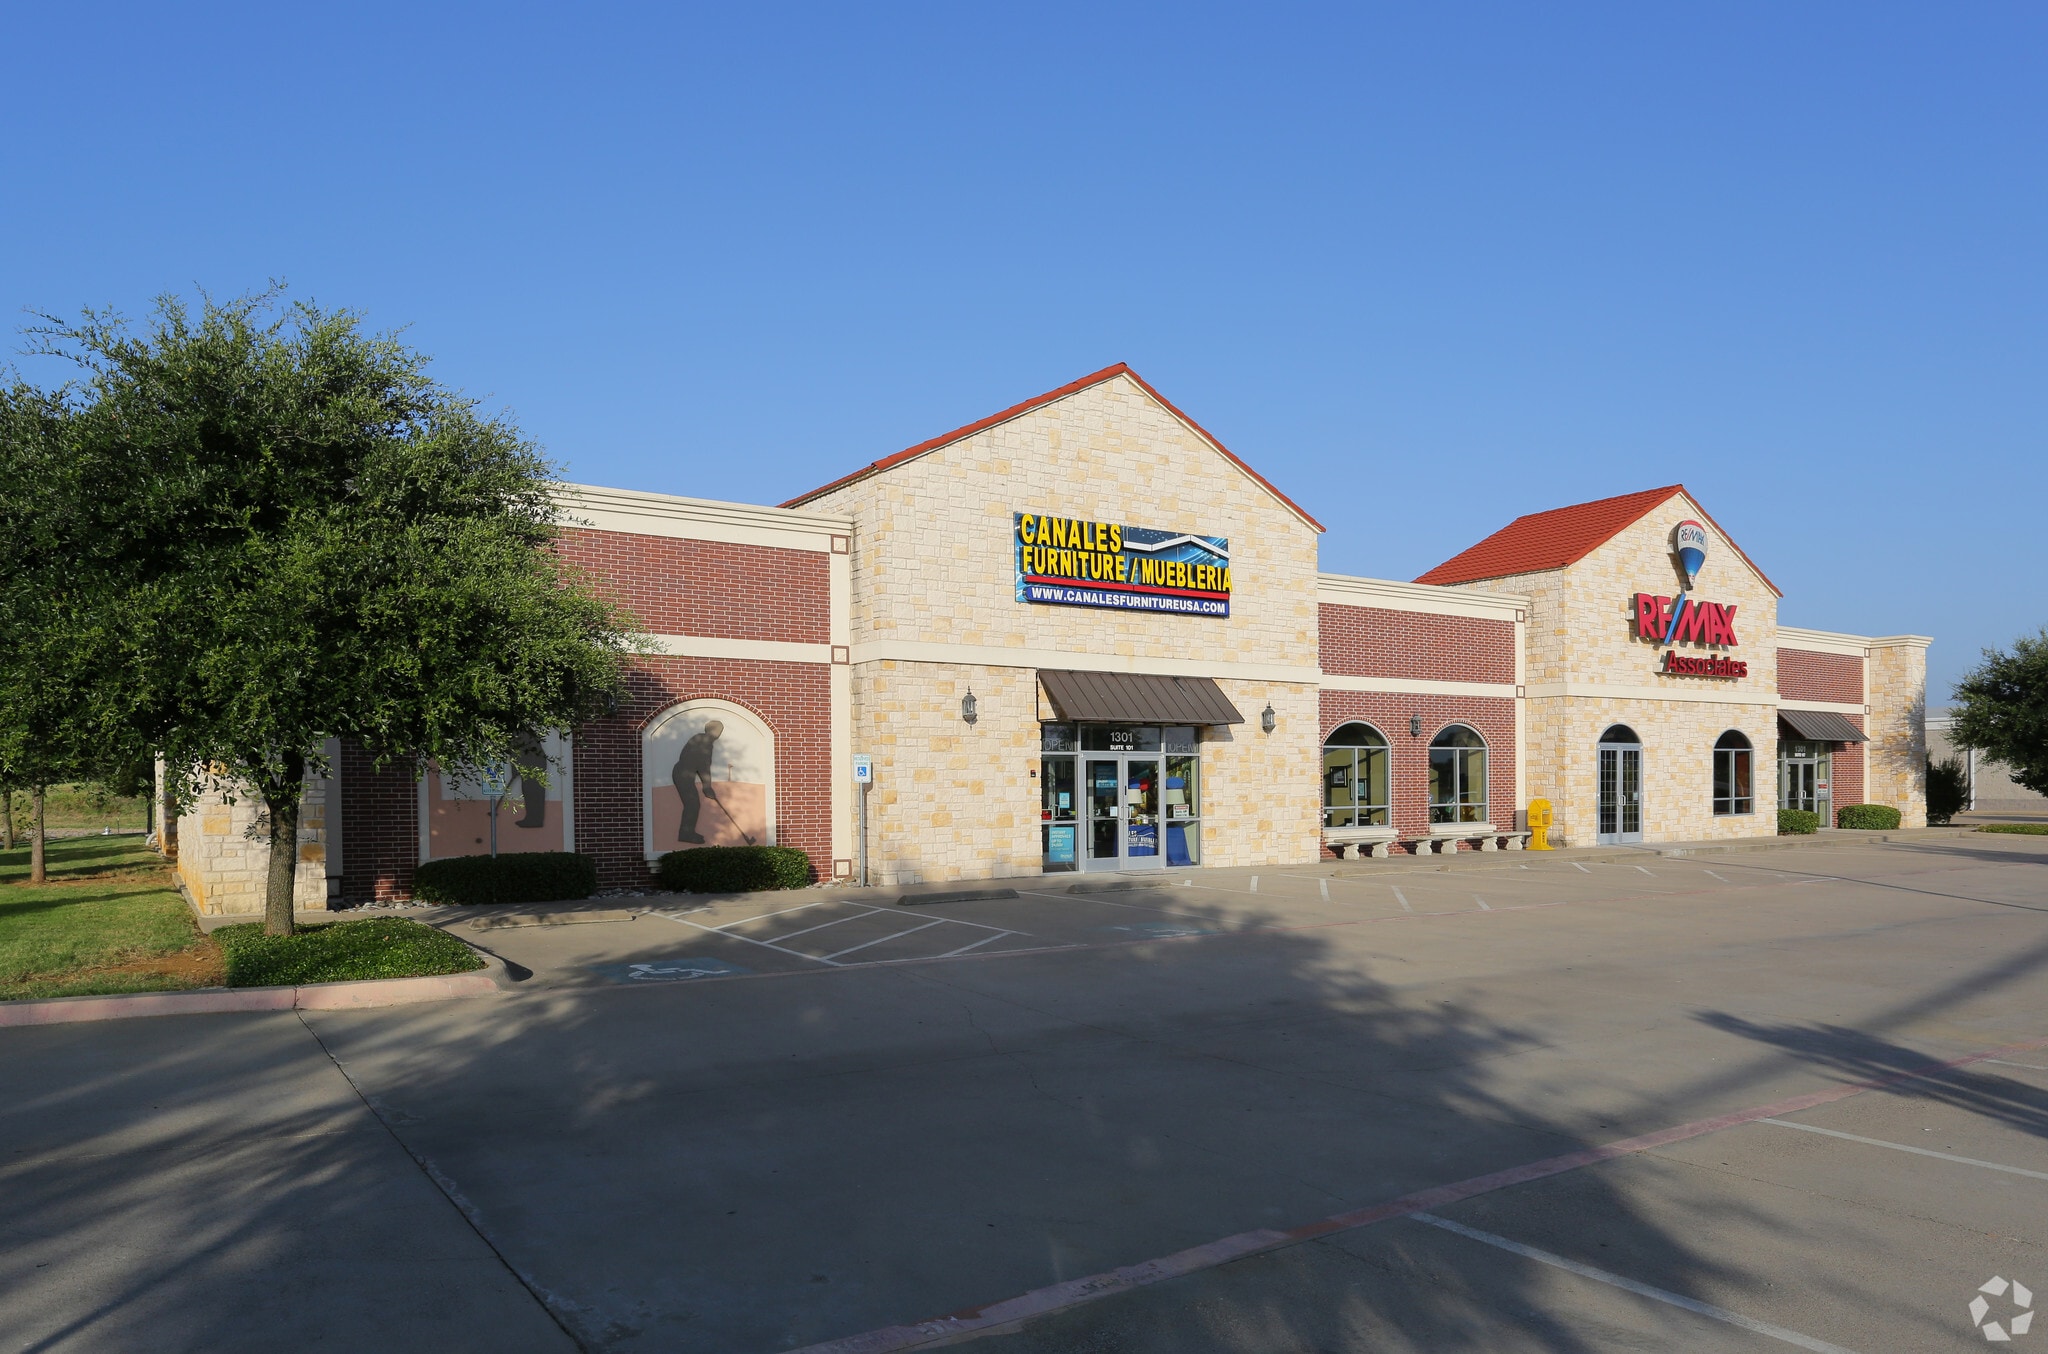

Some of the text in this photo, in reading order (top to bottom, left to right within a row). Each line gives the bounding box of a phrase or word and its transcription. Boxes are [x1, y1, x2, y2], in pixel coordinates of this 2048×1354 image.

[1021, 514, 1121, 553] CANALES
[1680, 527, 1705, 546] RE/MAX
[1022, 546, 1125, 582] FURNITURE
[1142, 558, 1233, 592] MUEBLERIA
[1031, 587, 1226, 614] WWW.CANALESFURNITUREUSA.COM
[1635, 593, 1738, 646] RE/MAX
[1667, 650, 1748, 678] Associates
[1044, 739, 1073, 751] OPEN
[1110, 732, 1133, 743] 1301
[1169, 743, 1194, 753] OPEN
